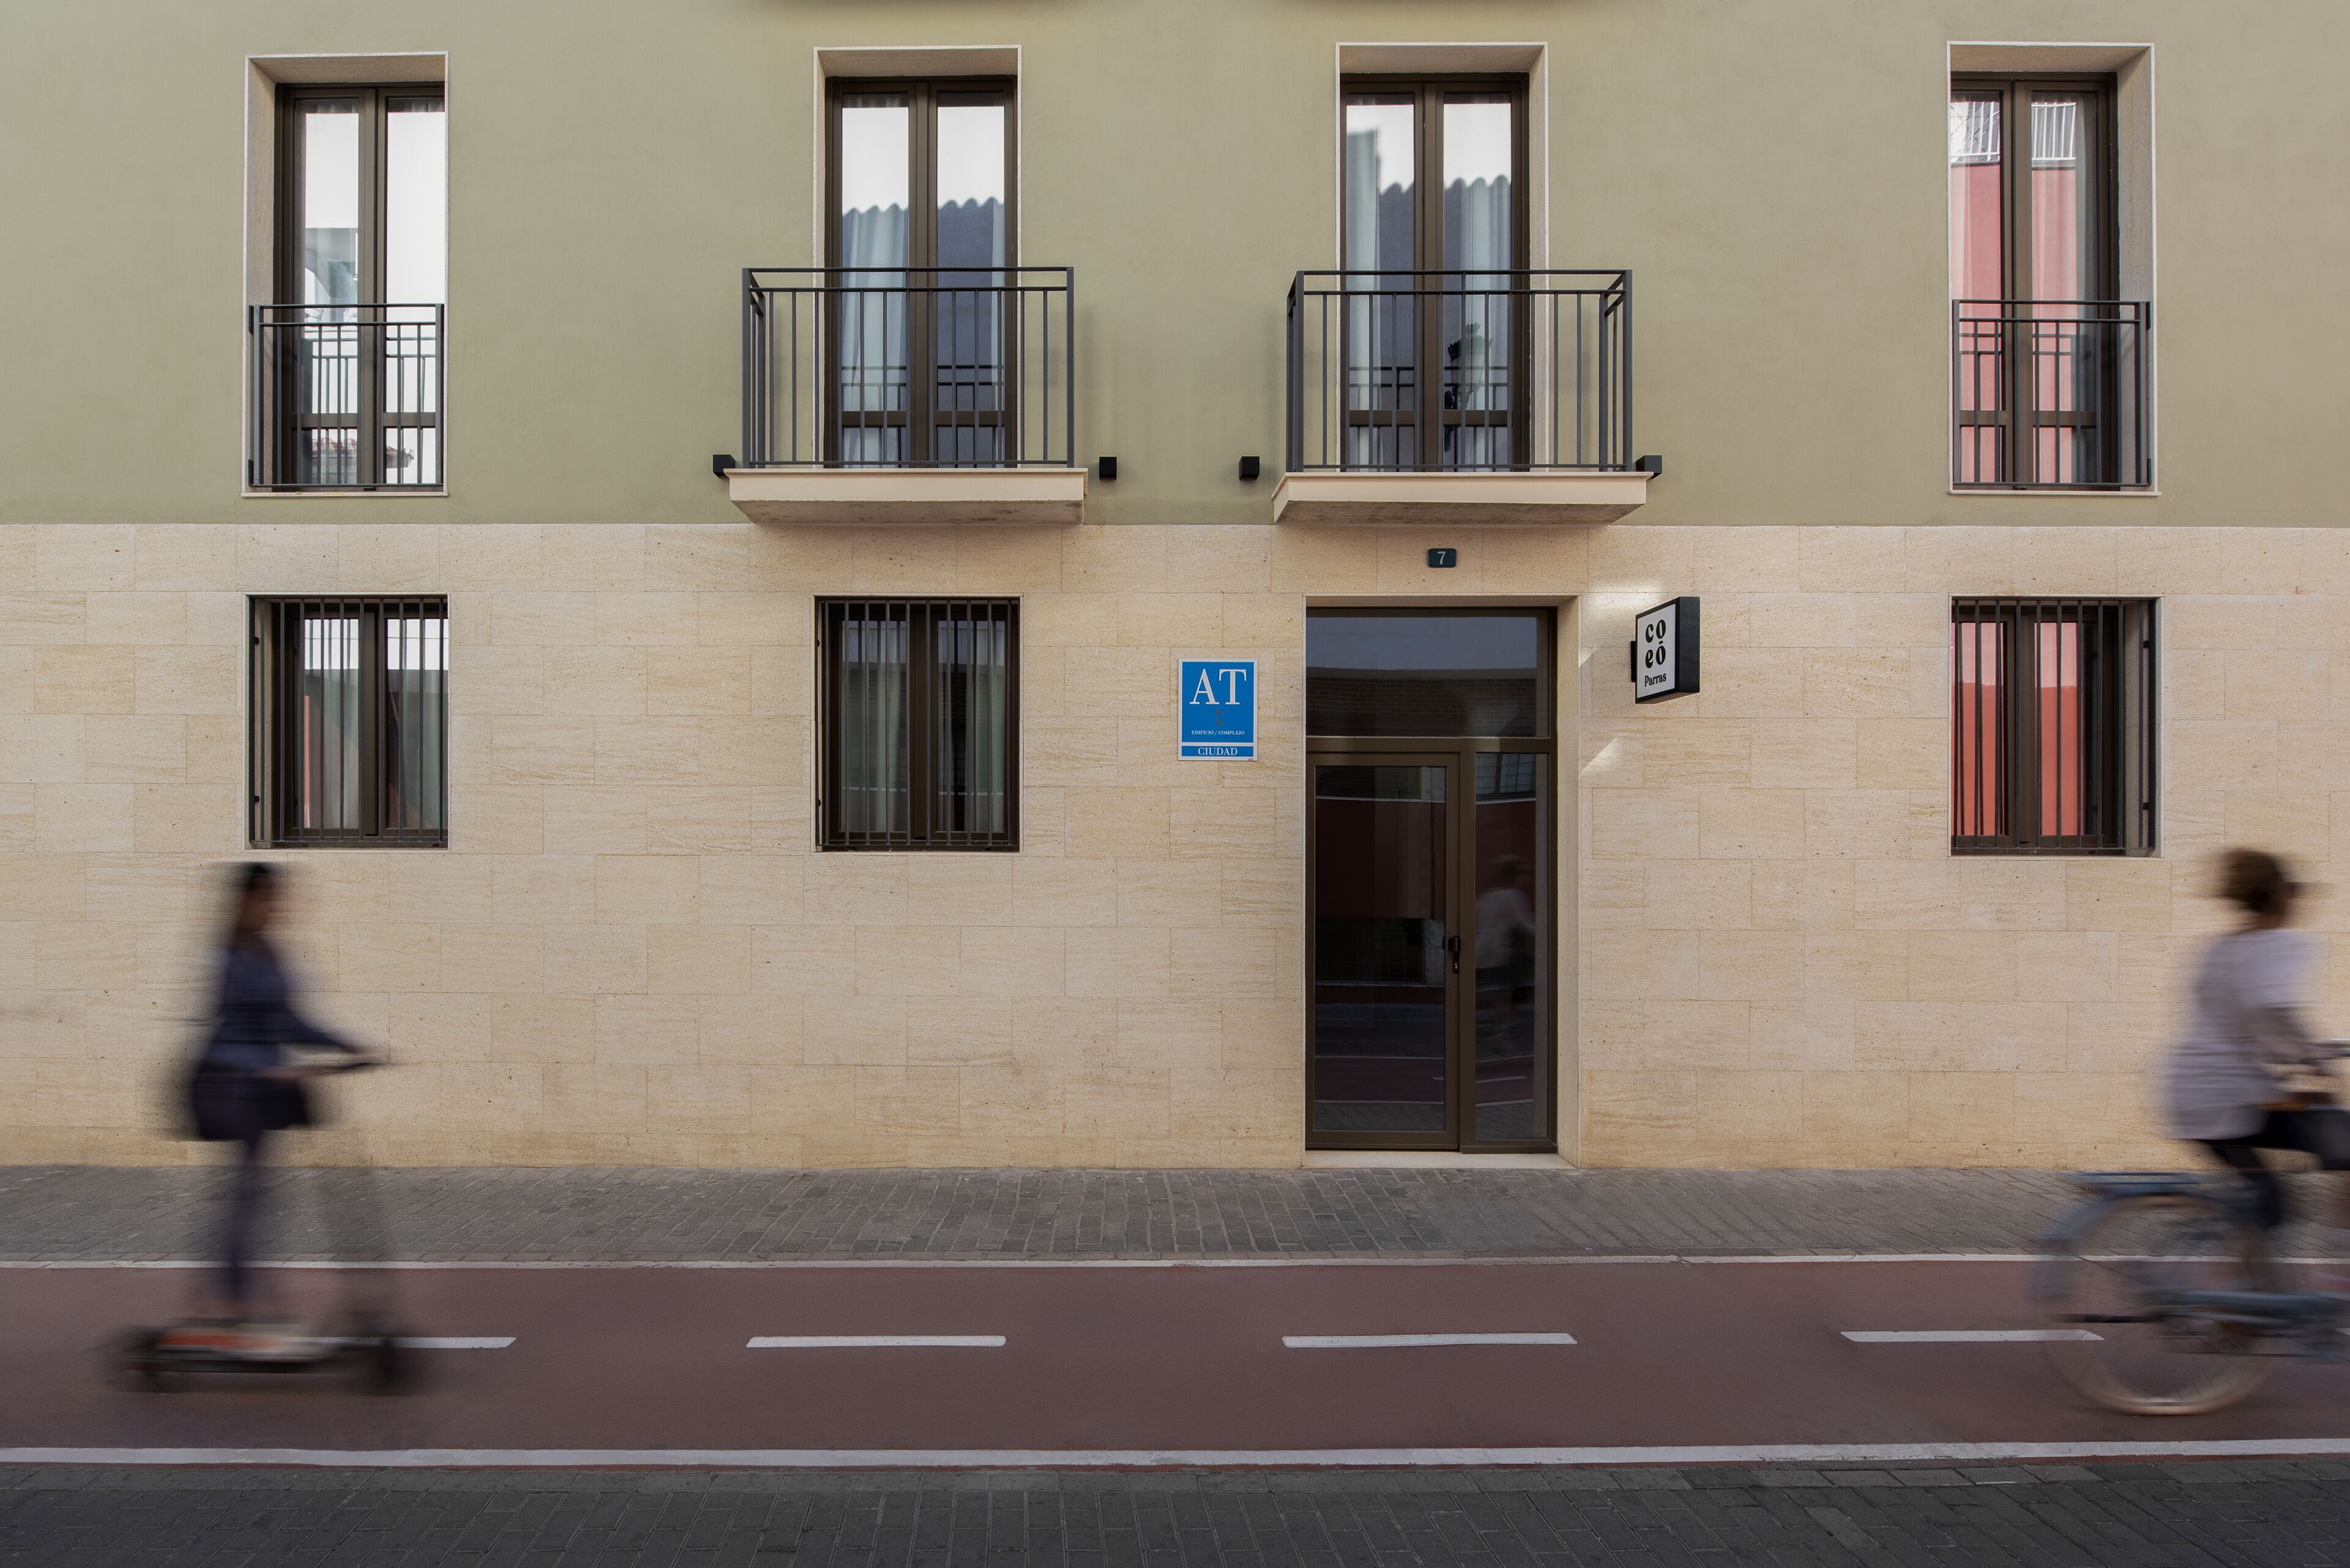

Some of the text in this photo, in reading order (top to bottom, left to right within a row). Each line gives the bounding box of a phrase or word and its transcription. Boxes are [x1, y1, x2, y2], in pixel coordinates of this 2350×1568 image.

[1437, 551, 1446, 565] 7
[1645, 619, 1666, 643] co
[1189, 668, 1247, 704] AT
[1644, 673, 1667, 687] Parras
[1198, 747, 1238, 756] CIUDAD
